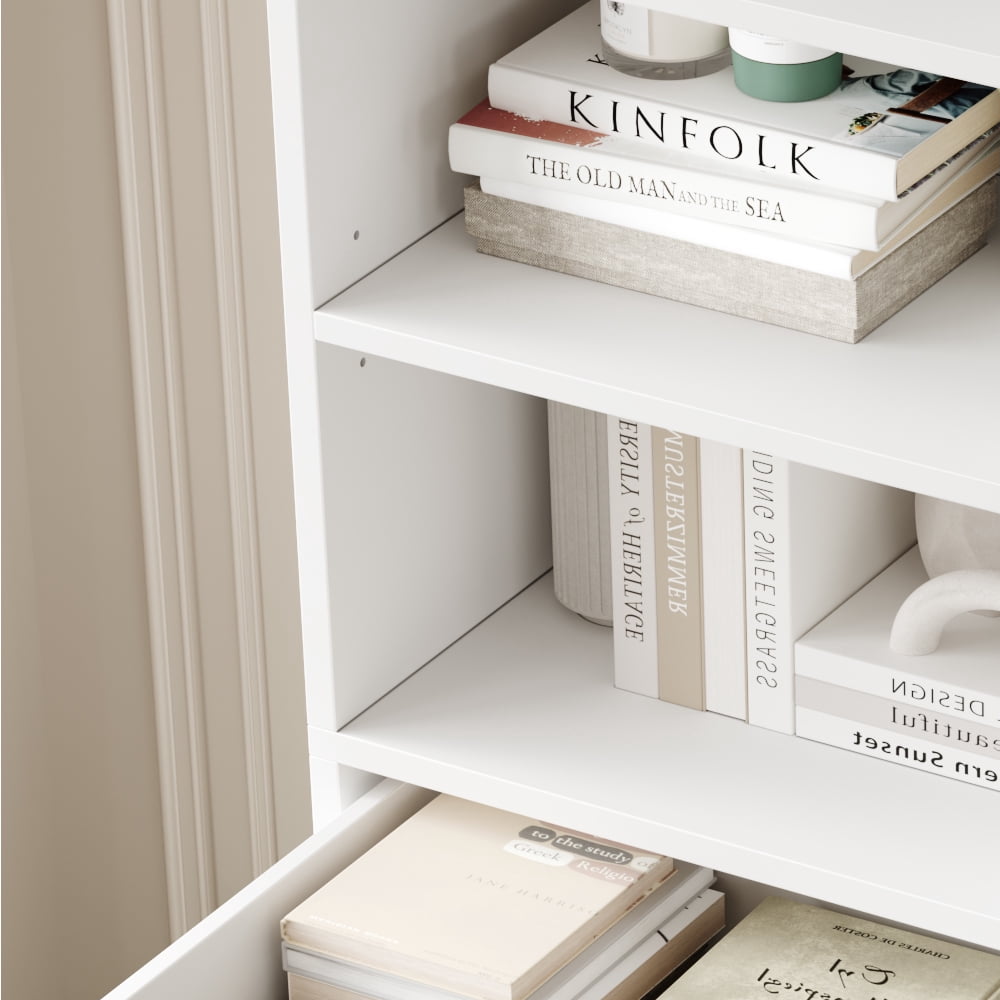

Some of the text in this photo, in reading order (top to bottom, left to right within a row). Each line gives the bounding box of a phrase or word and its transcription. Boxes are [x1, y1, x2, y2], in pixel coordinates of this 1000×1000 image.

[568, 90, 821, 180] KINFOLK
[526, 155, 787, 223] THE OLD MAN AND THE SEA
[513, 842, 636, 883] Greek Religio
[531, 829, 550, 840] to
[555, 836, 583, 850] the
[585, 843, 632, 864] study
